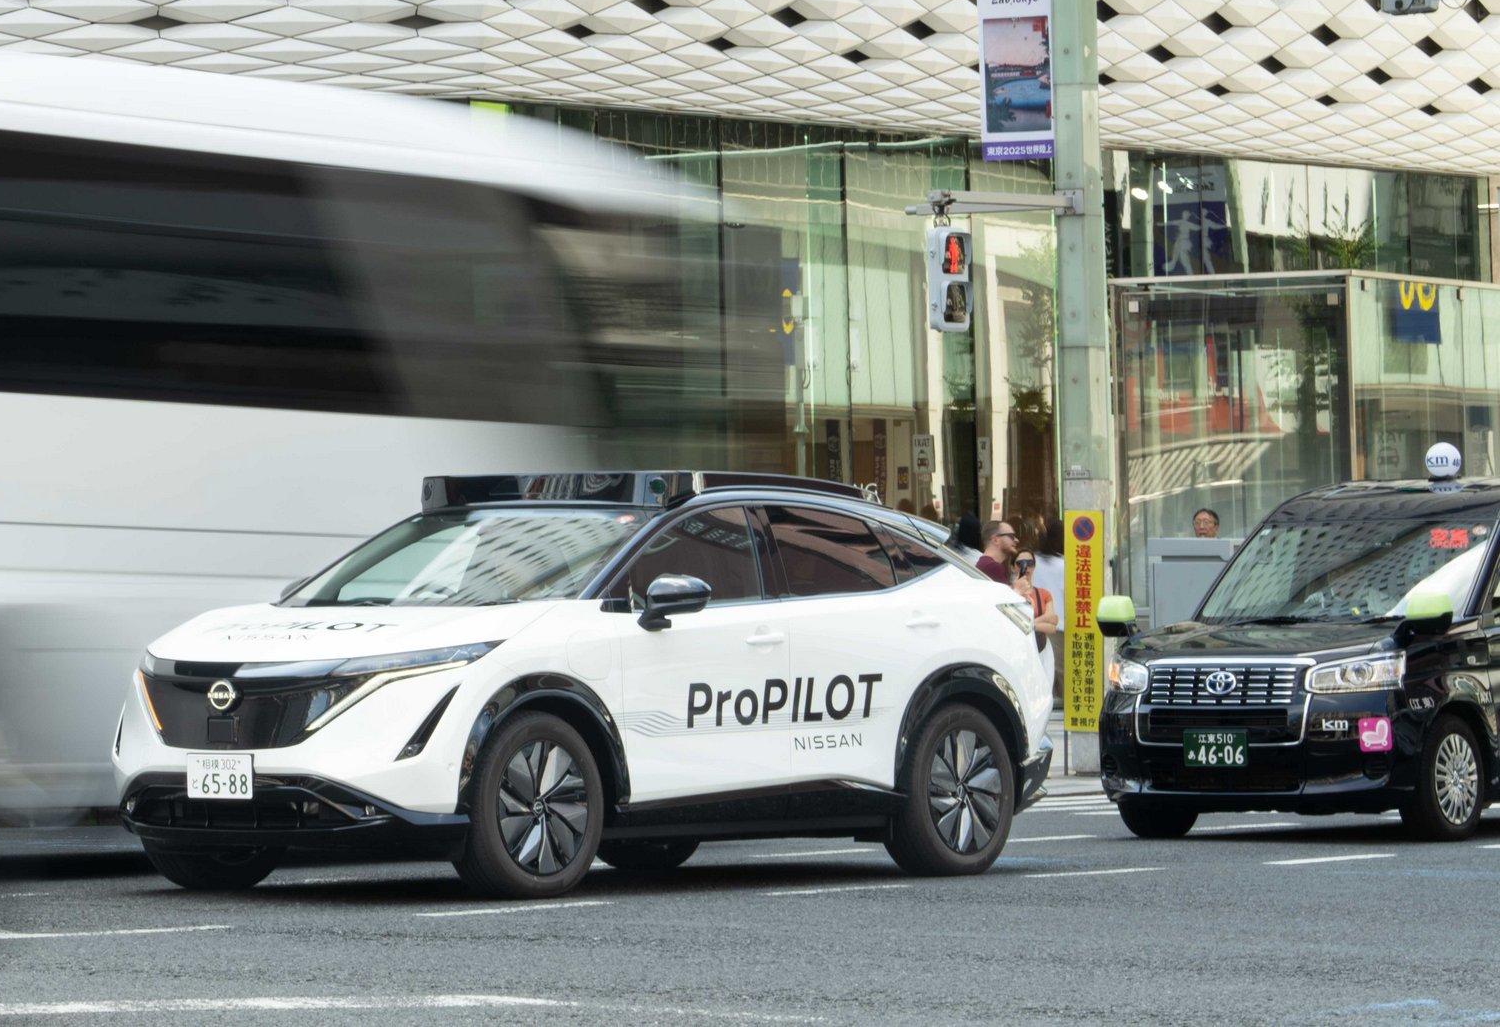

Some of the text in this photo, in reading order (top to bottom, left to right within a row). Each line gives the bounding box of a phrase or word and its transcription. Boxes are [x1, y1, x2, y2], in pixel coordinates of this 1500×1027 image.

[1075, 544, 1092, 629] 違法駐車禁止
[207, 691, 236, 700] NISSAN
[686, 672, 884, 729] ProPILOT
[1322, 718, 1349, 731] km
[794, 733, 863, 751] NISSAN
[1198, 745, 1244, 765] 46-06
[202, 773, 248, 794] 65-88
